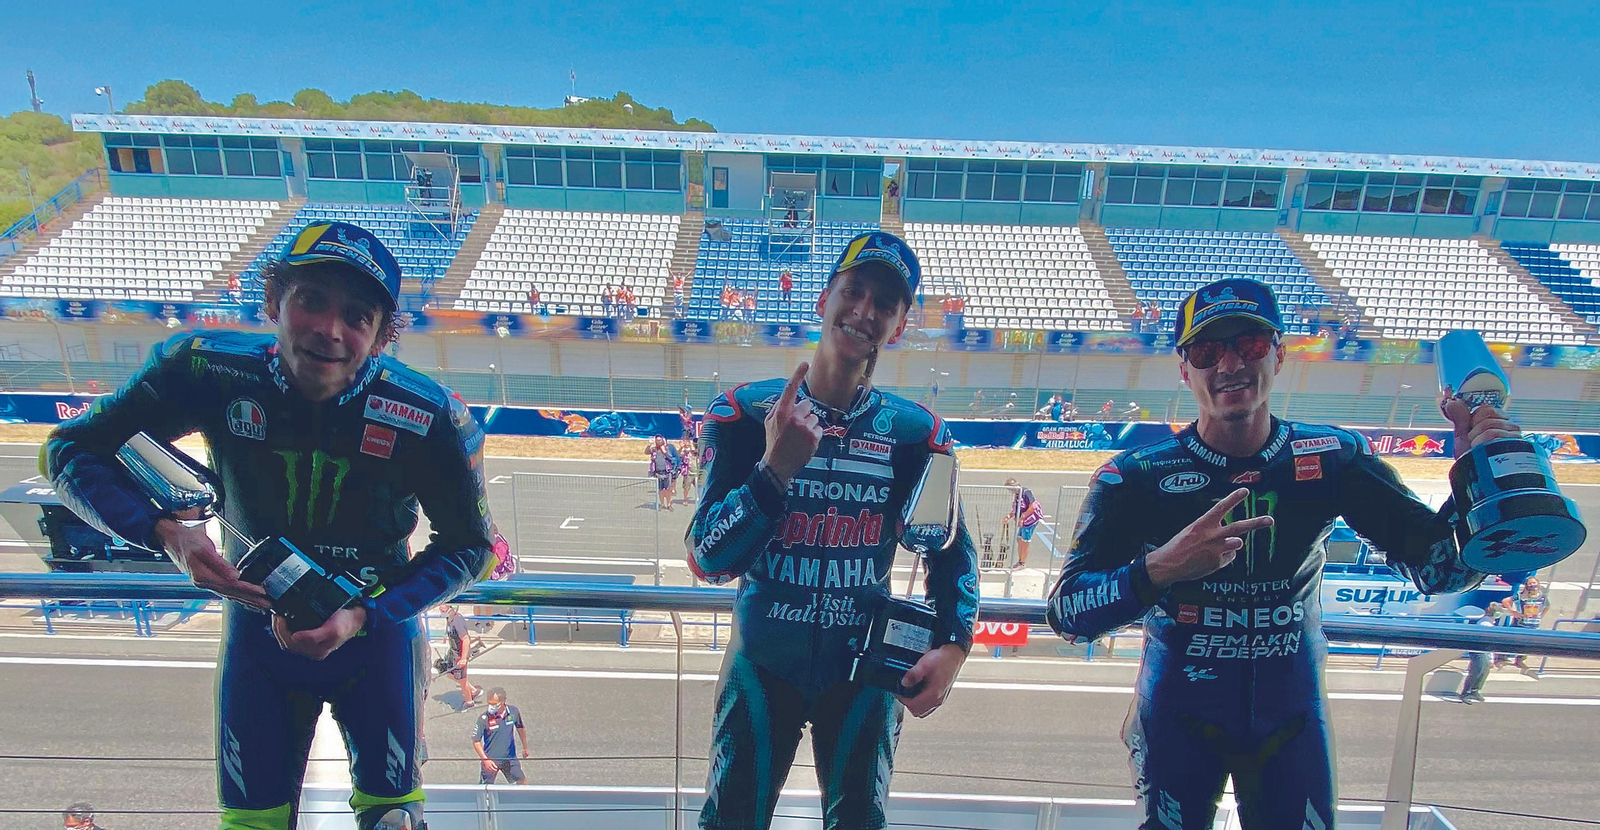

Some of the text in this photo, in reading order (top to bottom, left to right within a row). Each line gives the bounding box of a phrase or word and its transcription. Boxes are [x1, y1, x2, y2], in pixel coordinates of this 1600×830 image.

[314, 243, 386, 281] MICHELIN
[857, 250, 911, 278] MICHELIN
[1193, 303, 1257, 325] MICHELIN
[385, 401, 430, 426] YAMAHA
[860, 441, 889, 454] YAMAHA
[863, 432, 896, 444] PETRONAS
[1261, 425, 1290, 461] YAMAHA
[1303, 438, 1338, 448] YAMAHA
[1187, 438, 1227, 468] YAMAHA
[787, 477, 890, 503] ETRONAS
[765, 552, 878, 588] YAMAHA
[1202, 579, 1290, 595] MONSTER
[1216, 594, 1281, 603] ENERGY
[811, 592, 855, 612] Visit
[1053, 580, 1121, 623] YAMAHA
[766, 601, 867, 629] Malaysia
[1203, 600, 1304, 629] ENEOS
[1190, 630, 1302, 647] SEMAKIN
[1216, 643, 1299, 660] DEPAN
